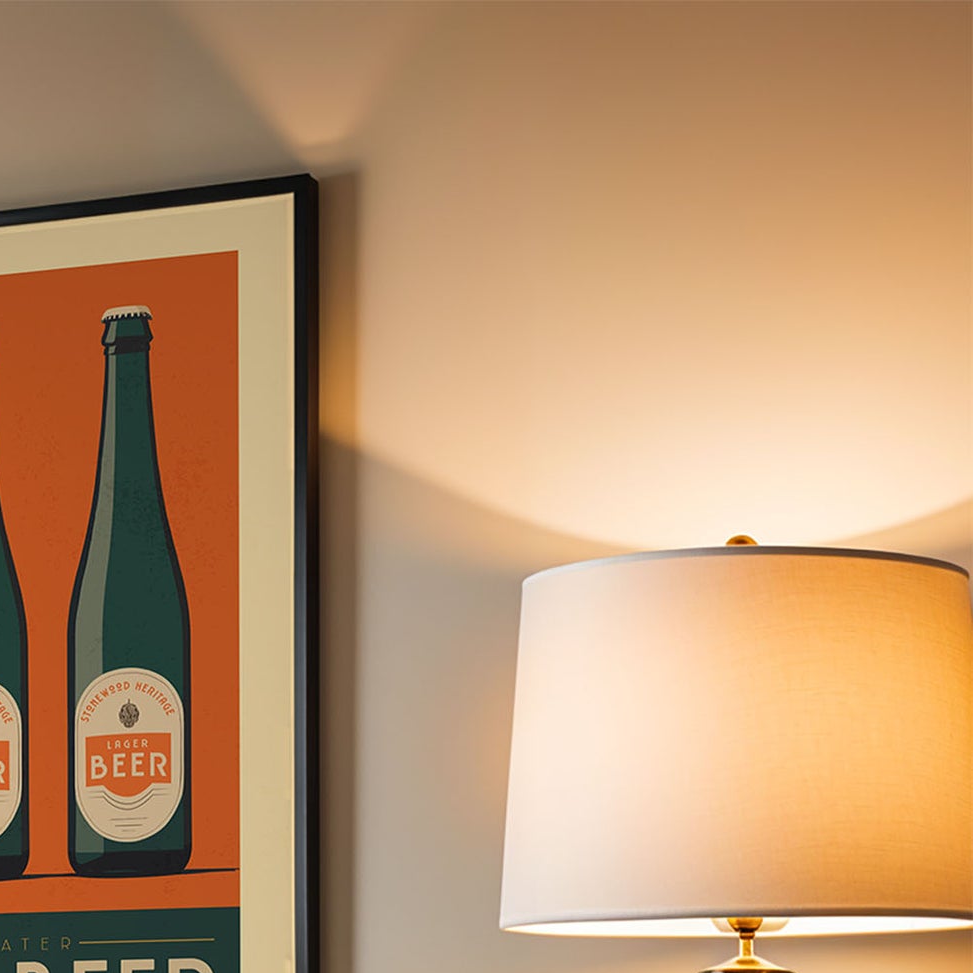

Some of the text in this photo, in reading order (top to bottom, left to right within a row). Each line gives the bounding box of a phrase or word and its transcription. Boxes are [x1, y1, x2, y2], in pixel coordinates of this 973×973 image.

[80, 681, 175, 723] STONEWOOD HERITAGE
[107, 738, 148, 750] LAGER
[90, 752, 167, 780] BEER
